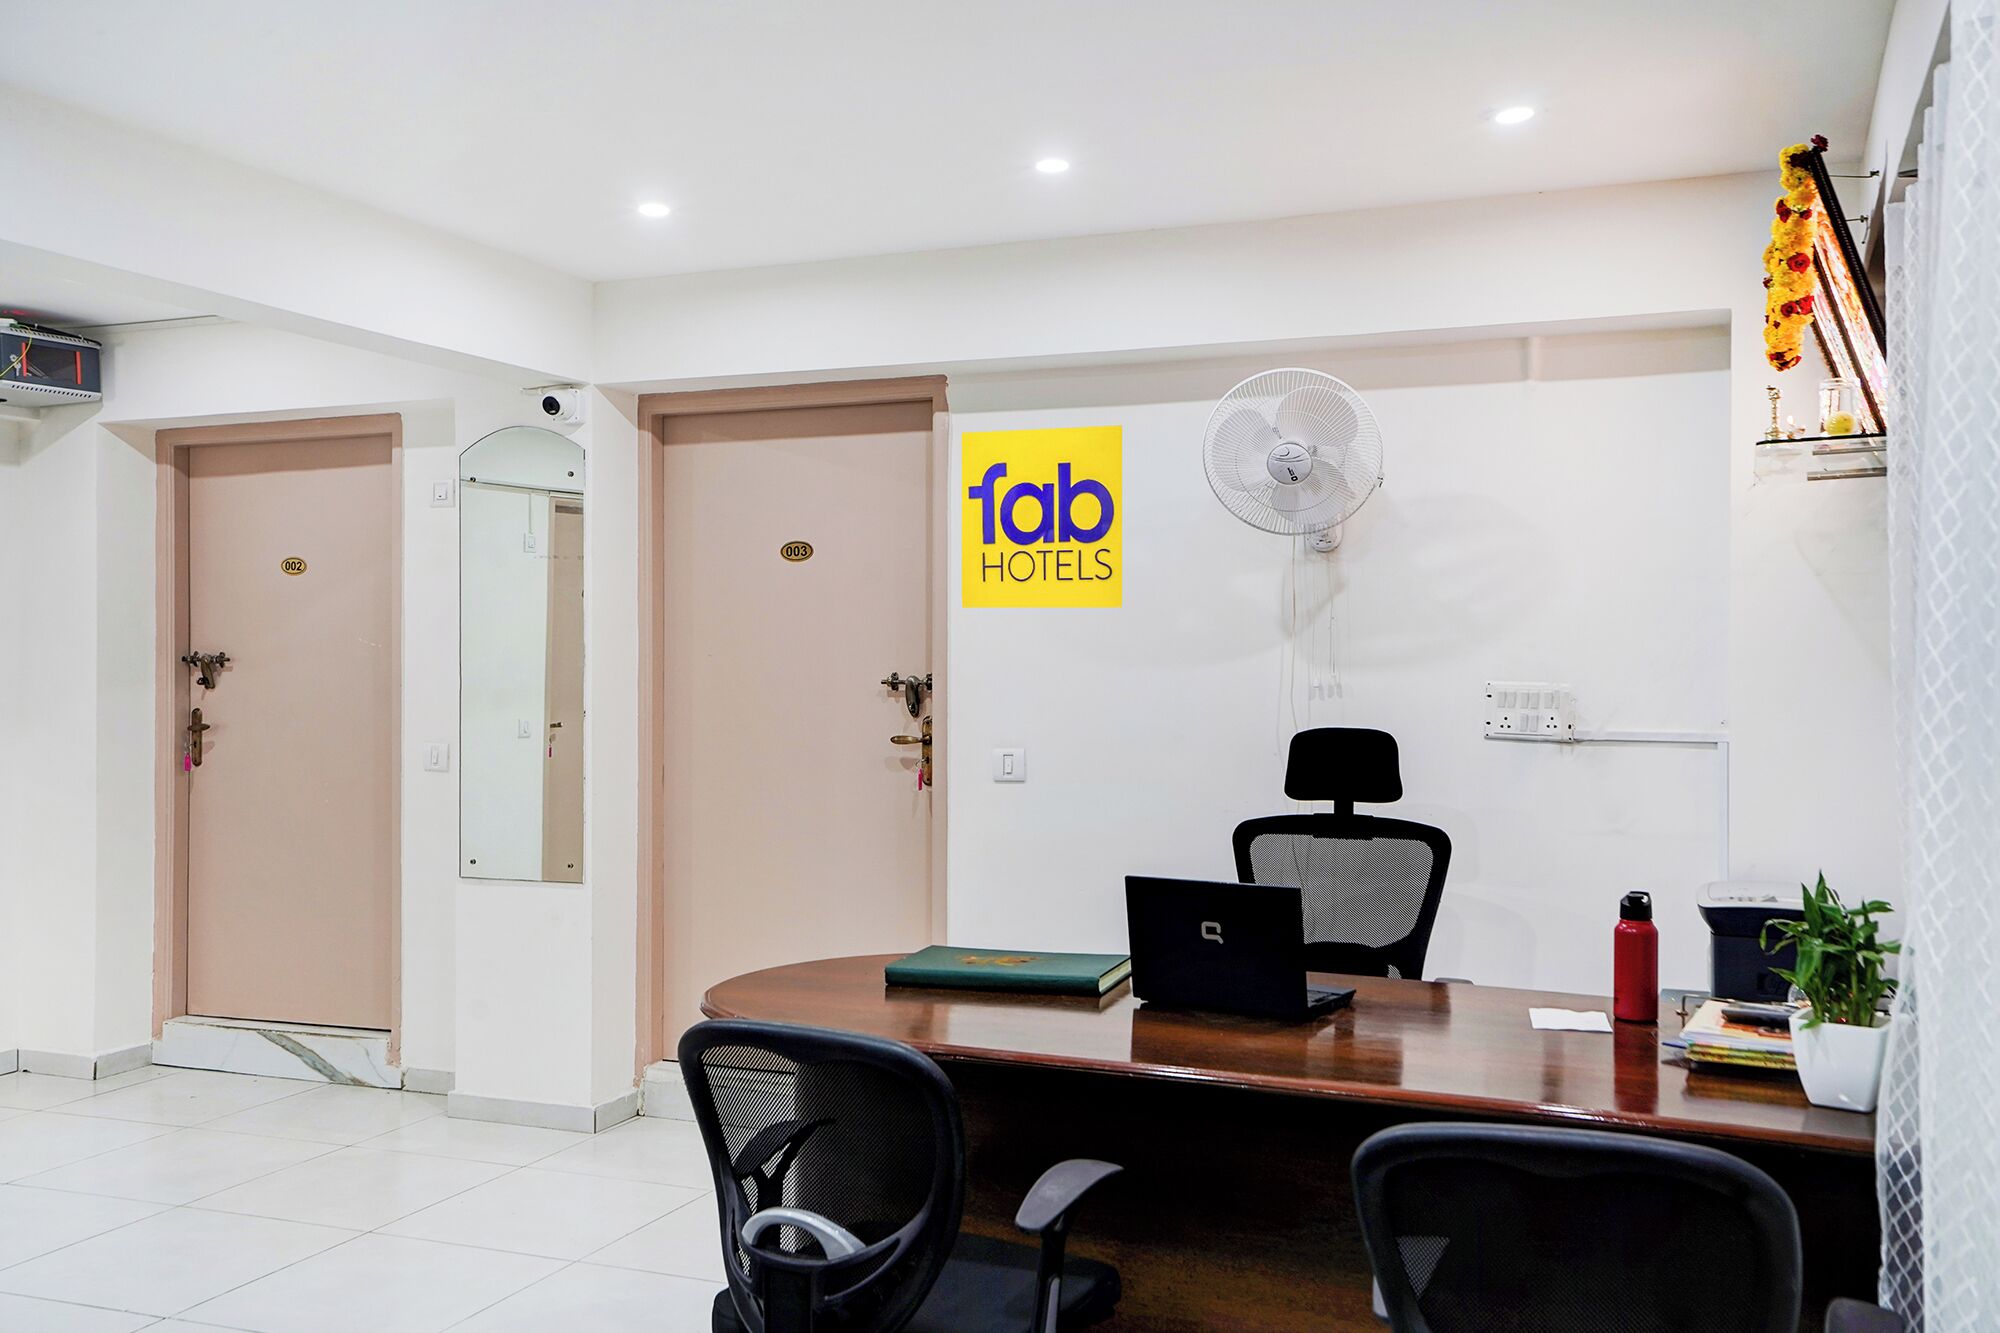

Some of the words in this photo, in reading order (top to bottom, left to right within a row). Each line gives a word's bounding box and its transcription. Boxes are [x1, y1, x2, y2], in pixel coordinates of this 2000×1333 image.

[968, 462, 1114, 545] fab
[785, 545, 807, 557] 003
[285, 561, 302, 571] 002
[982, 548, 1113, 582] HOTELS
